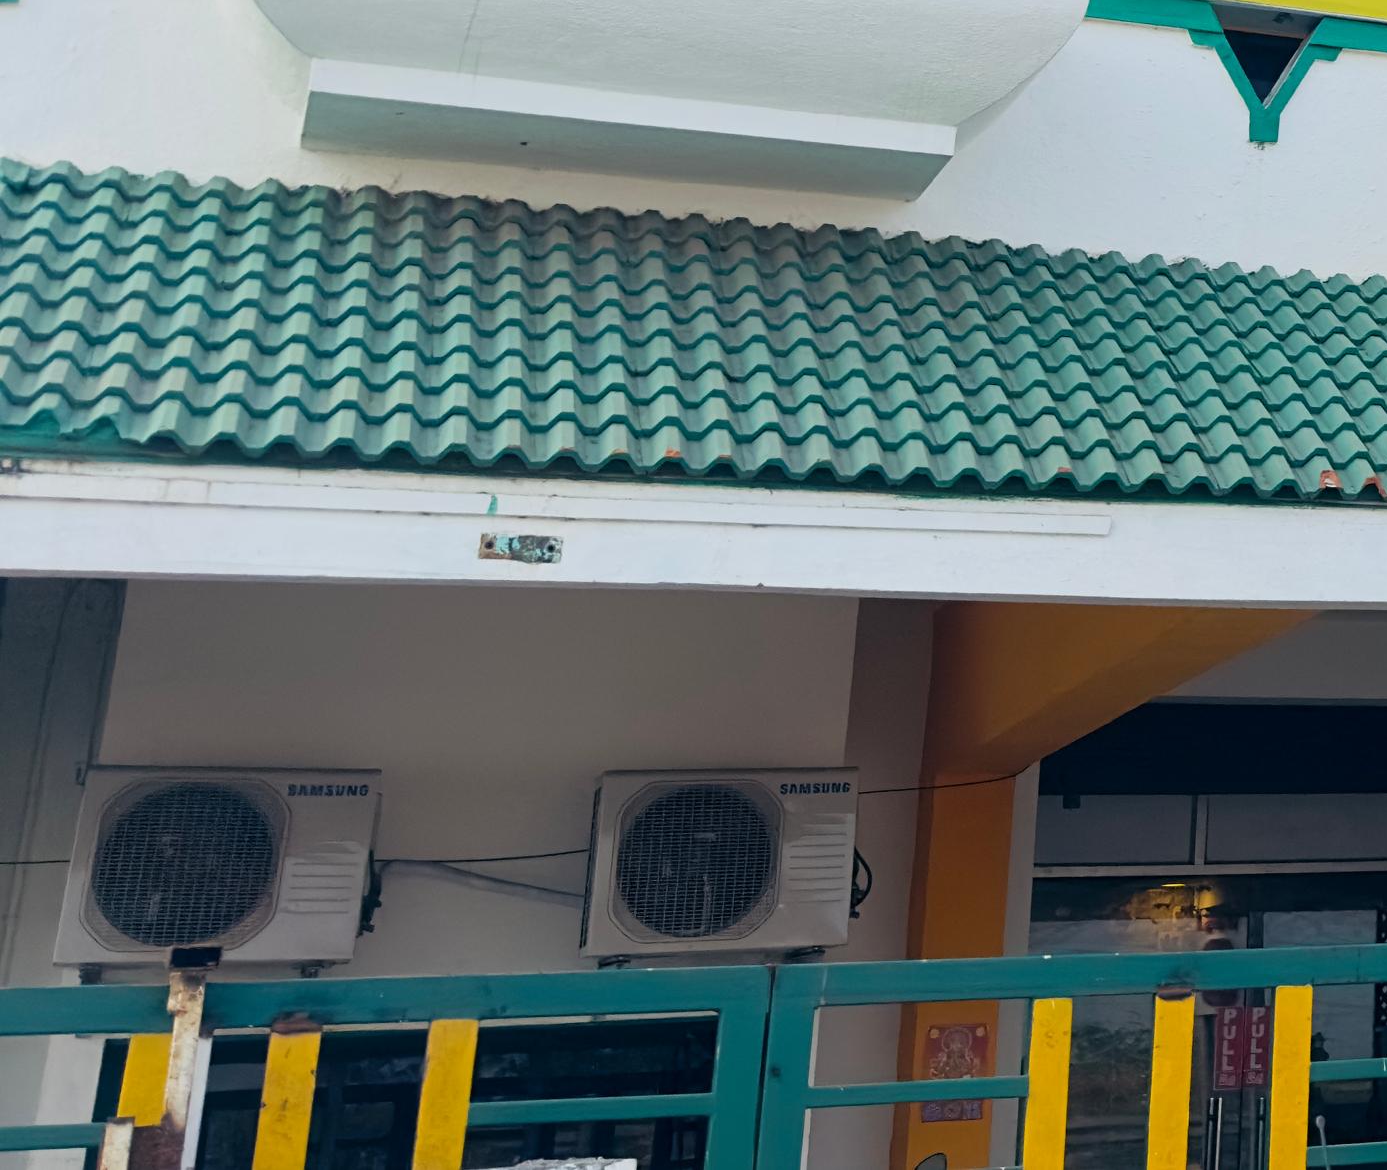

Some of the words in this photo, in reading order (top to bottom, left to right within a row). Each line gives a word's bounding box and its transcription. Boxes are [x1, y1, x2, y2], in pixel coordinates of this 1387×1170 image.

[287, 783, 370, 797] SAMSUNG
[780, 782, 851, 796] SAMSUNG
[1221, 1008, 1238, 1071] PULL
[1250, 1006, 1266, 1070] PULL
